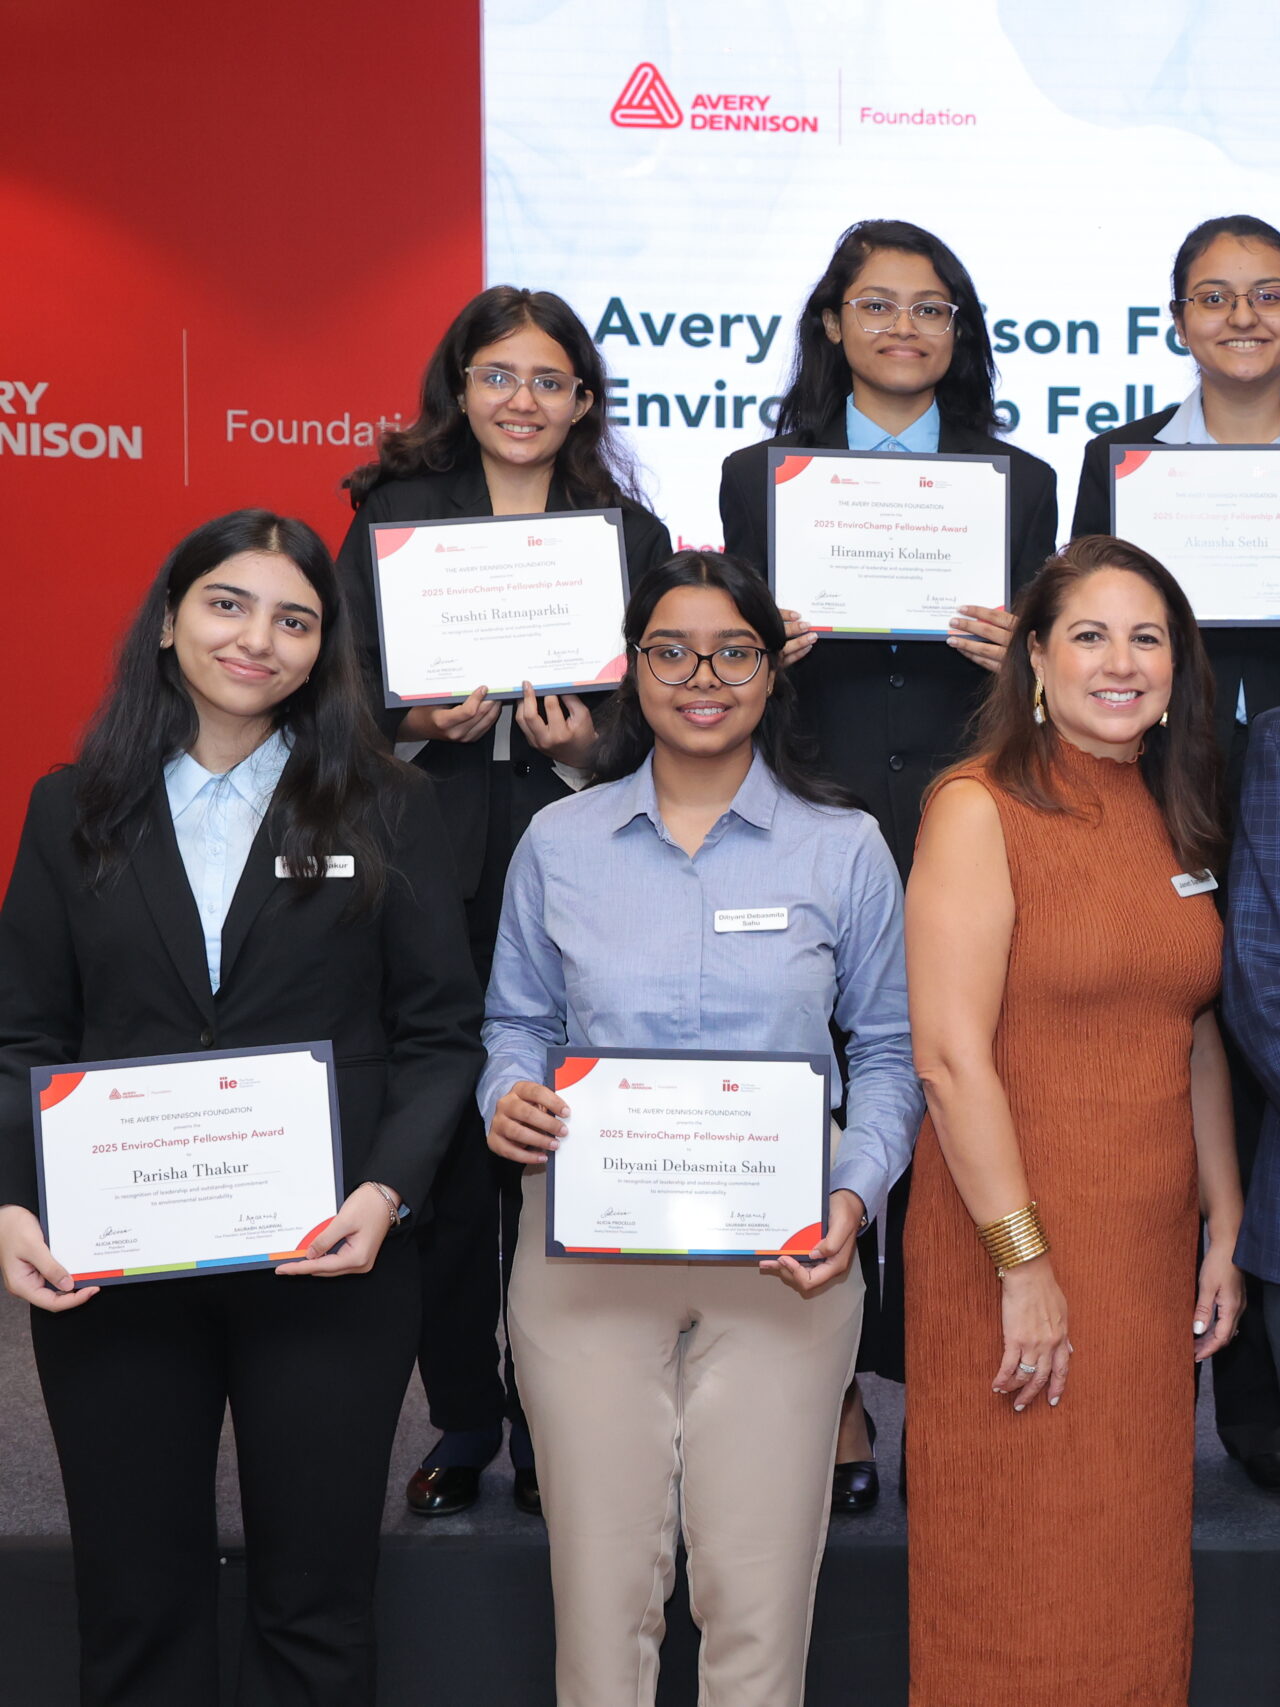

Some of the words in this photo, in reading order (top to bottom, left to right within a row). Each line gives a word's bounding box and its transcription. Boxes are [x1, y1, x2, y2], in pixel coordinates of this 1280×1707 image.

[691, 94, 771, 111] AVERY
[690, 114, 818, 132] DENNISON
[859, 107, 977, 126] Foundation
[594, 296, 782, 364] Avery
[814, 519, 835, 528] 2025
[837, 520, 893, 532] EnviroChamp
[895, 522, 939, 533] Fellowship
[941, 524, 968, 533] Award
[1238, 536, 1268, 548] Sethi
[831, 545, 894, 562] Hiranmayi
[898, 547, 951, 561] Kolambe
[421, 588, 444, 597] 2025
[446, 585, 504, 595] EnviroChamp
[506, 581, 553, 590] Fellowship
[555, 578, 583, 587] Award
[441, 608, 487, 624] Srushti
[136, 1115, 159, 1123] AVERY
[161, 1111, 201, 1121] DENNISON
[202, 1106, 252, 1116] FOUNDATION
[91, 1143, 118, 1154] 2025
[121, 1138, 190, 1151] EnviroChamp
[192, 1131, 248, 1143] Fellowship
[250, 1126, 284, 1138] Award
[599, 1129, 623, 1138] 2025
[626, 1130, 690, 1142] EnviroChamp
[693, 1131, 745, 1143] Fellowship
[747, 1133, 779, 1142] Award
[133, 1166, 188, 1183] Parisha
[193, 1161, 249, 1178] Thakur
[603, 1157, 657, 1174] Dibyani
[663, 1159, 737, 1174] Debasmita
[741, 1160, 776, 1174] Sahu
